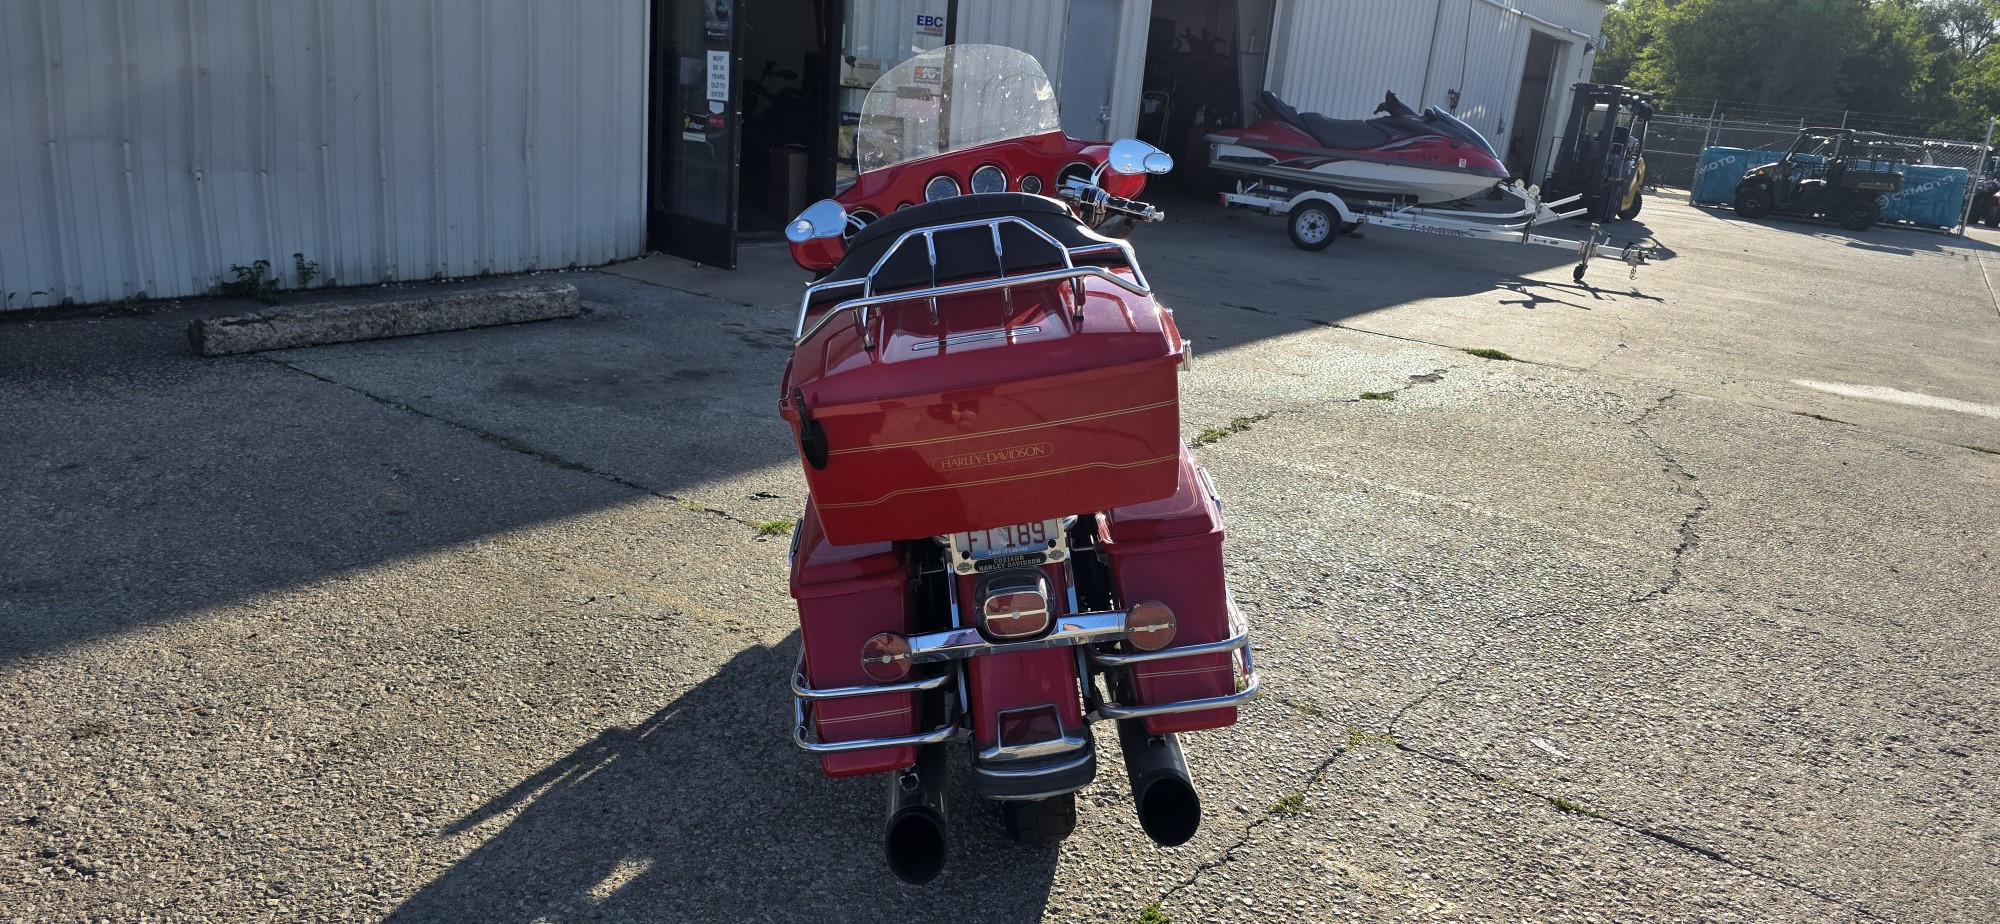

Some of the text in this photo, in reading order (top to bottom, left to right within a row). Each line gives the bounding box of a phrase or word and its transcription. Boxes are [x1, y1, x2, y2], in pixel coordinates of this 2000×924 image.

[917, 15, 943, 27] EBC
[688, 122, 705, 131] thor
[1892, 175, 1954, 201] CFMOTO
[941, 445, 1045, 469] HARLEY-DAVIDSON
[1006, 521, 1046, 547] 189
[979, 558, 1042, 572] HARLEY-DAVIDSON
